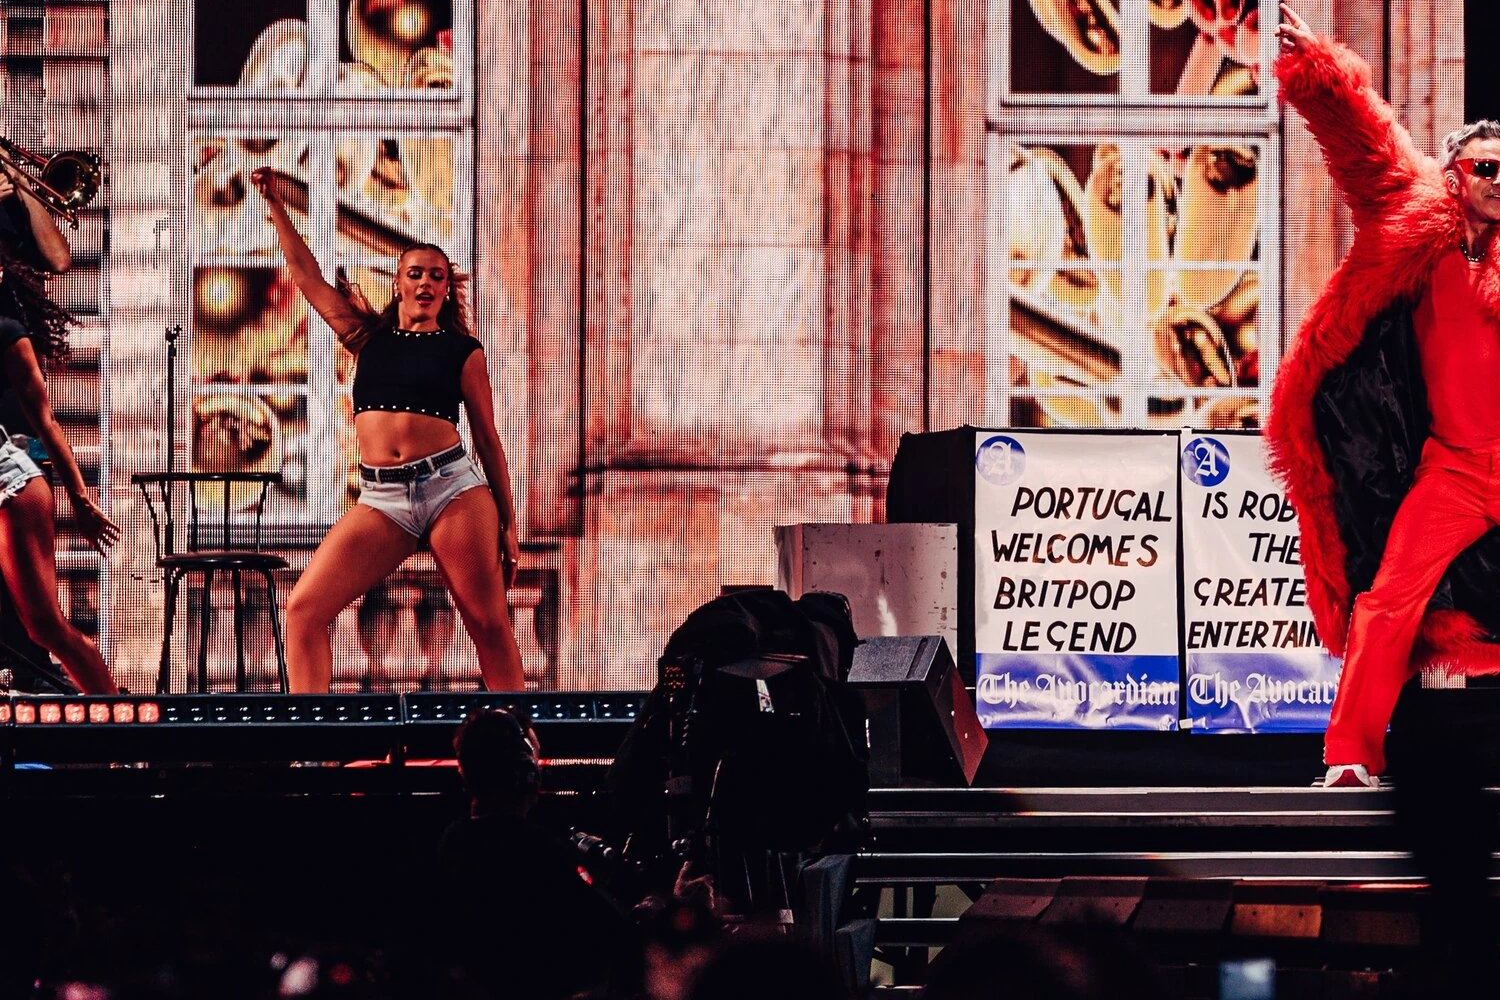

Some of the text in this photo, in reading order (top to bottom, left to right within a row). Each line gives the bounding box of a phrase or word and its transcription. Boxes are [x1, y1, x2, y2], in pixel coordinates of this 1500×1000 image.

[989, 440, 1012, 475] A
[1194, 445, 1219, 477] A
[1011, 487, 1172, 522] PORTUGAL
[1202, 491, 1228, 519] IS
[991, 530, 1158, 567] WELCOMES
[1249, 533, 1303, 565] THE
[993, 577, 1136, 611] BRITPOP
[1003, 620, 1137, 653] LEGEND
[978, 672, 1177, 708] The Avocardian
[1188, 672, 1337, 709] The Avocar
